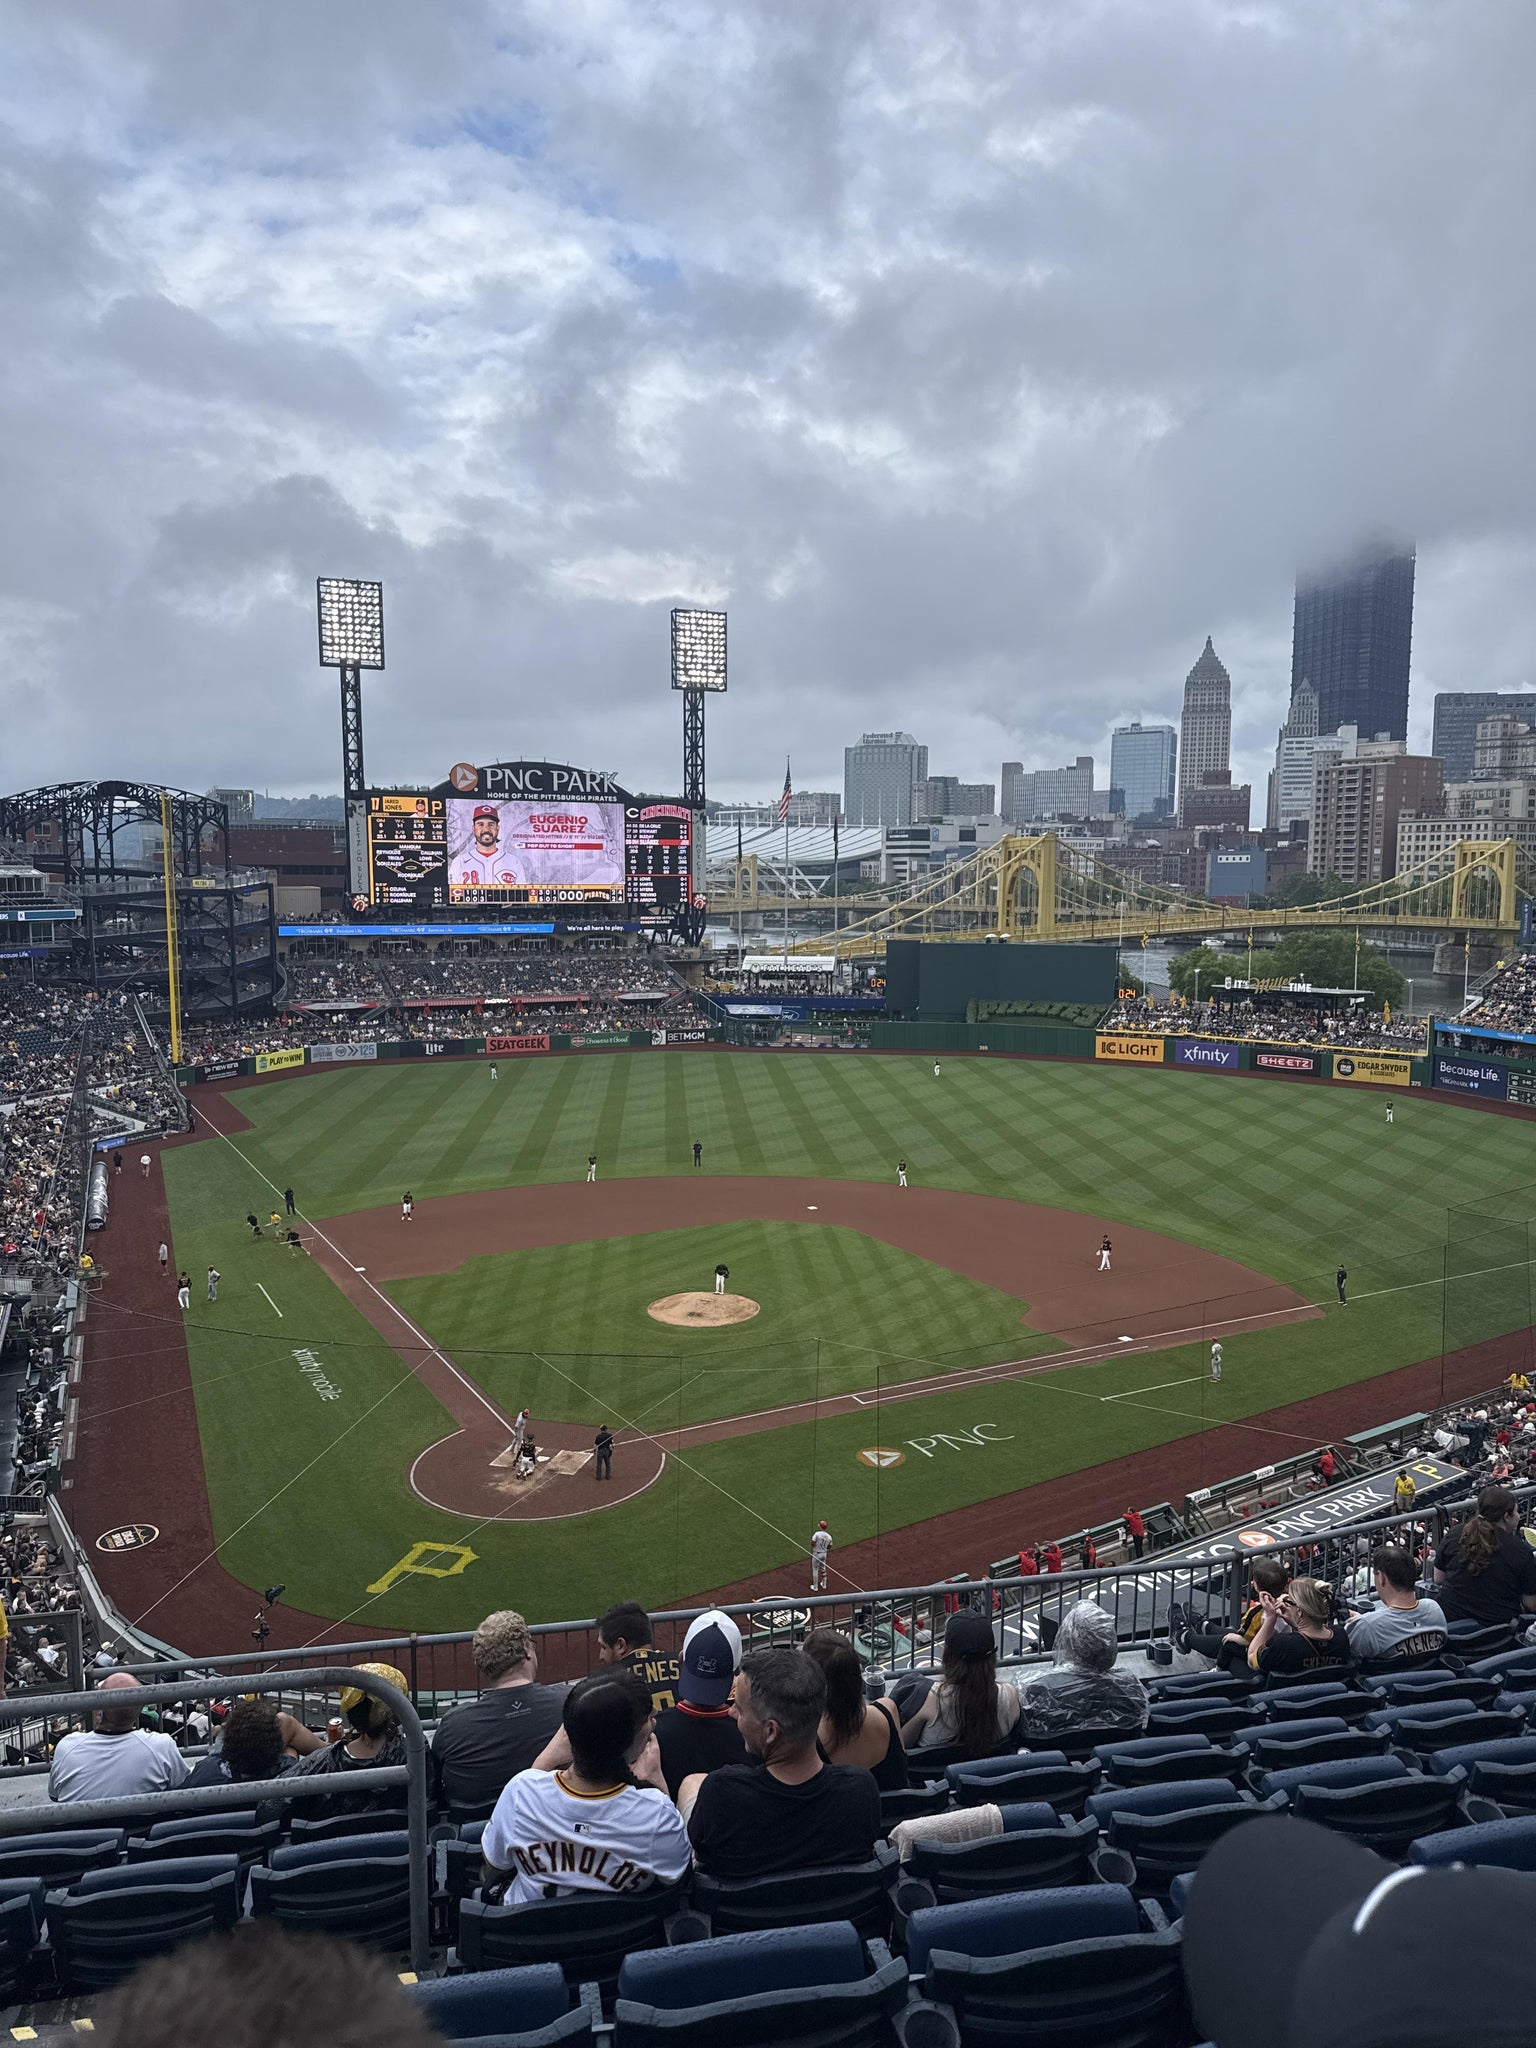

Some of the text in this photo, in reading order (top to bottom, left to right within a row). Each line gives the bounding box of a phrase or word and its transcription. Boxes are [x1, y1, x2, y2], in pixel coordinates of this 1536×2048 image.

[483, 767, 619, 794] PNC PARK
[540, 794, 586, 802] PITTSBURGH
[640, 804, 692, 821] CINCINNATI
[529, 815, 589, 825] EUGENIO
[532, 824, 586, 834] SUAREZ
[584, 890, 610, 901] PIRATES
[567, 924, 583, 932] We're
[611, 924, 625, 932] play.
[763, 962, 781, 973] FAT
[870, 978, 887, 989] 0:24
[1234, 976, 1312, 994] IT'S Miller TIME
[1118, 988, 1136, 999] 0:24
[667, 1031, 705, 1041] BETMGM
[360, 1044, 375, 1056] 125
[425, 1043, 445, 1055] Lite
[489, 1037, 546, 1051] SEATGEEK
[1118, 1044, 1159, 1056] LIGHT
[269, 1055, 285, 1066] PLAY
[289, 1053, 303, 1063] WIN!
[1183, 1046, 1230, 1065] xfinity
[1260, 1056, 1310, 1068] SHEETZ
[1357, 1061, 1380, 1071] EDGAR
[1380, 1063, 1409, 1073] SNYDER
[1440, 1061, 1480, 1078] Because
[1480, 1068, 1500, 1082] Life.
[305, 1371, 343, 1402] mobile
[902, 1423, 1016, 1458] PNC
[1411, 1463, 1443, 1481] P
[1262, 1485, 1392, 1540] PNC PARK
[365, 1541, 481, 1594] P
[1395, 1630, 1446, 1657] SKENES
[627, 1659, 681, 1684] ENES
[513, 1840, 650, 1893] REYNOLDS
